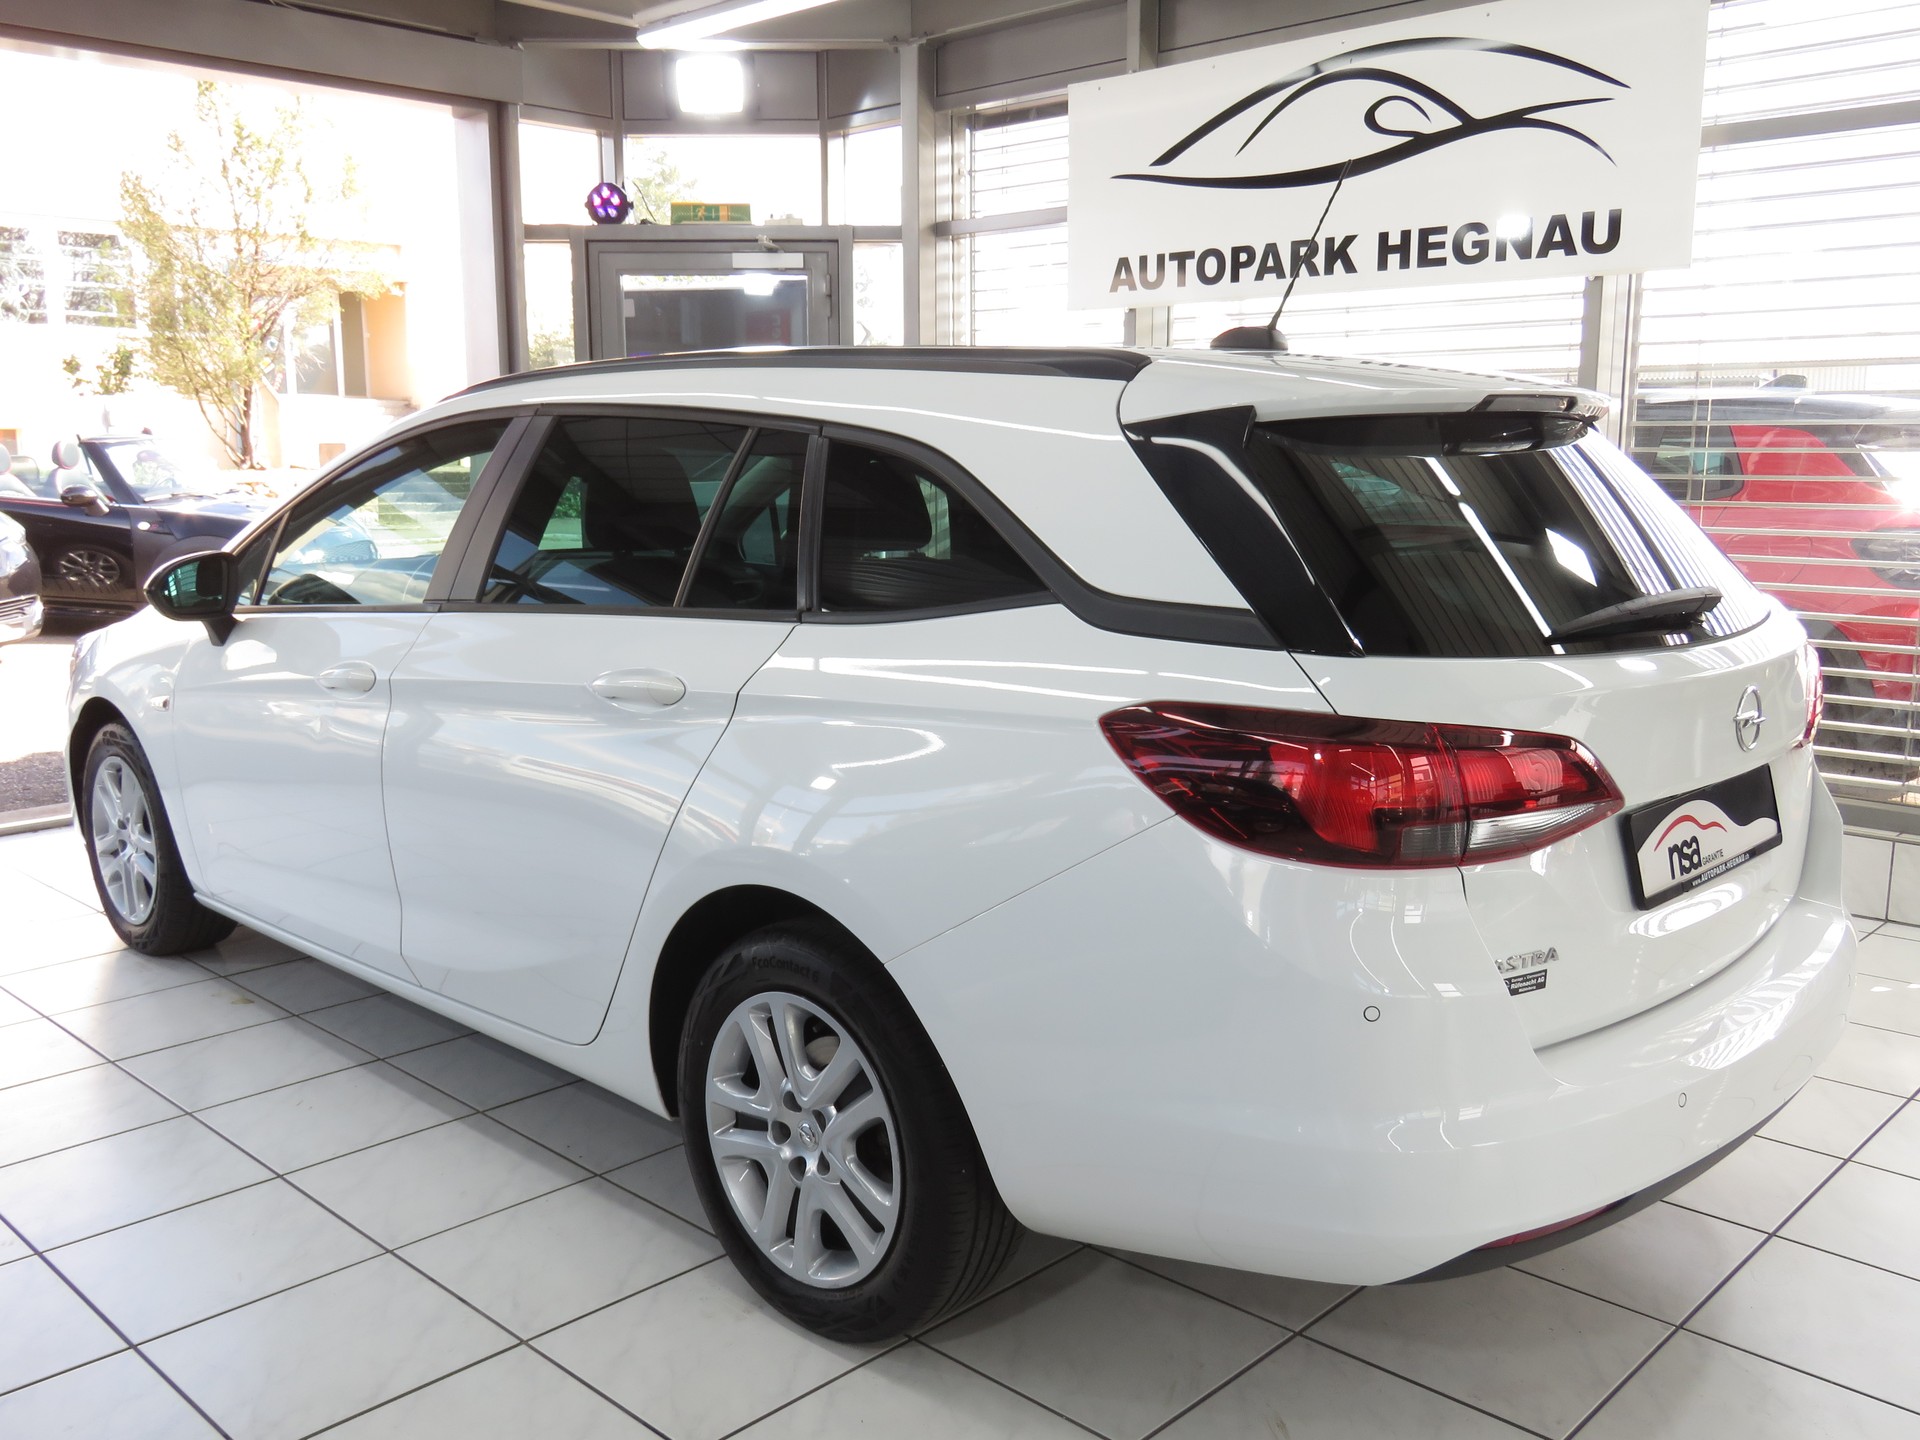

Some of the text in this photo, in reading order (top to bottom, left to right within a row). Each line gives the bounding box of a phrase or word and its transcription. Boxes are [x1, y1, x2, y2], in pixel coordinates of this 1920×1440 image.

[1109, 208, 1623, 293] AUTOPARK HEGNAU
[1667, 835, 1702, 880] nsa
[1702, 849, 1724, 866] GARANTIE
